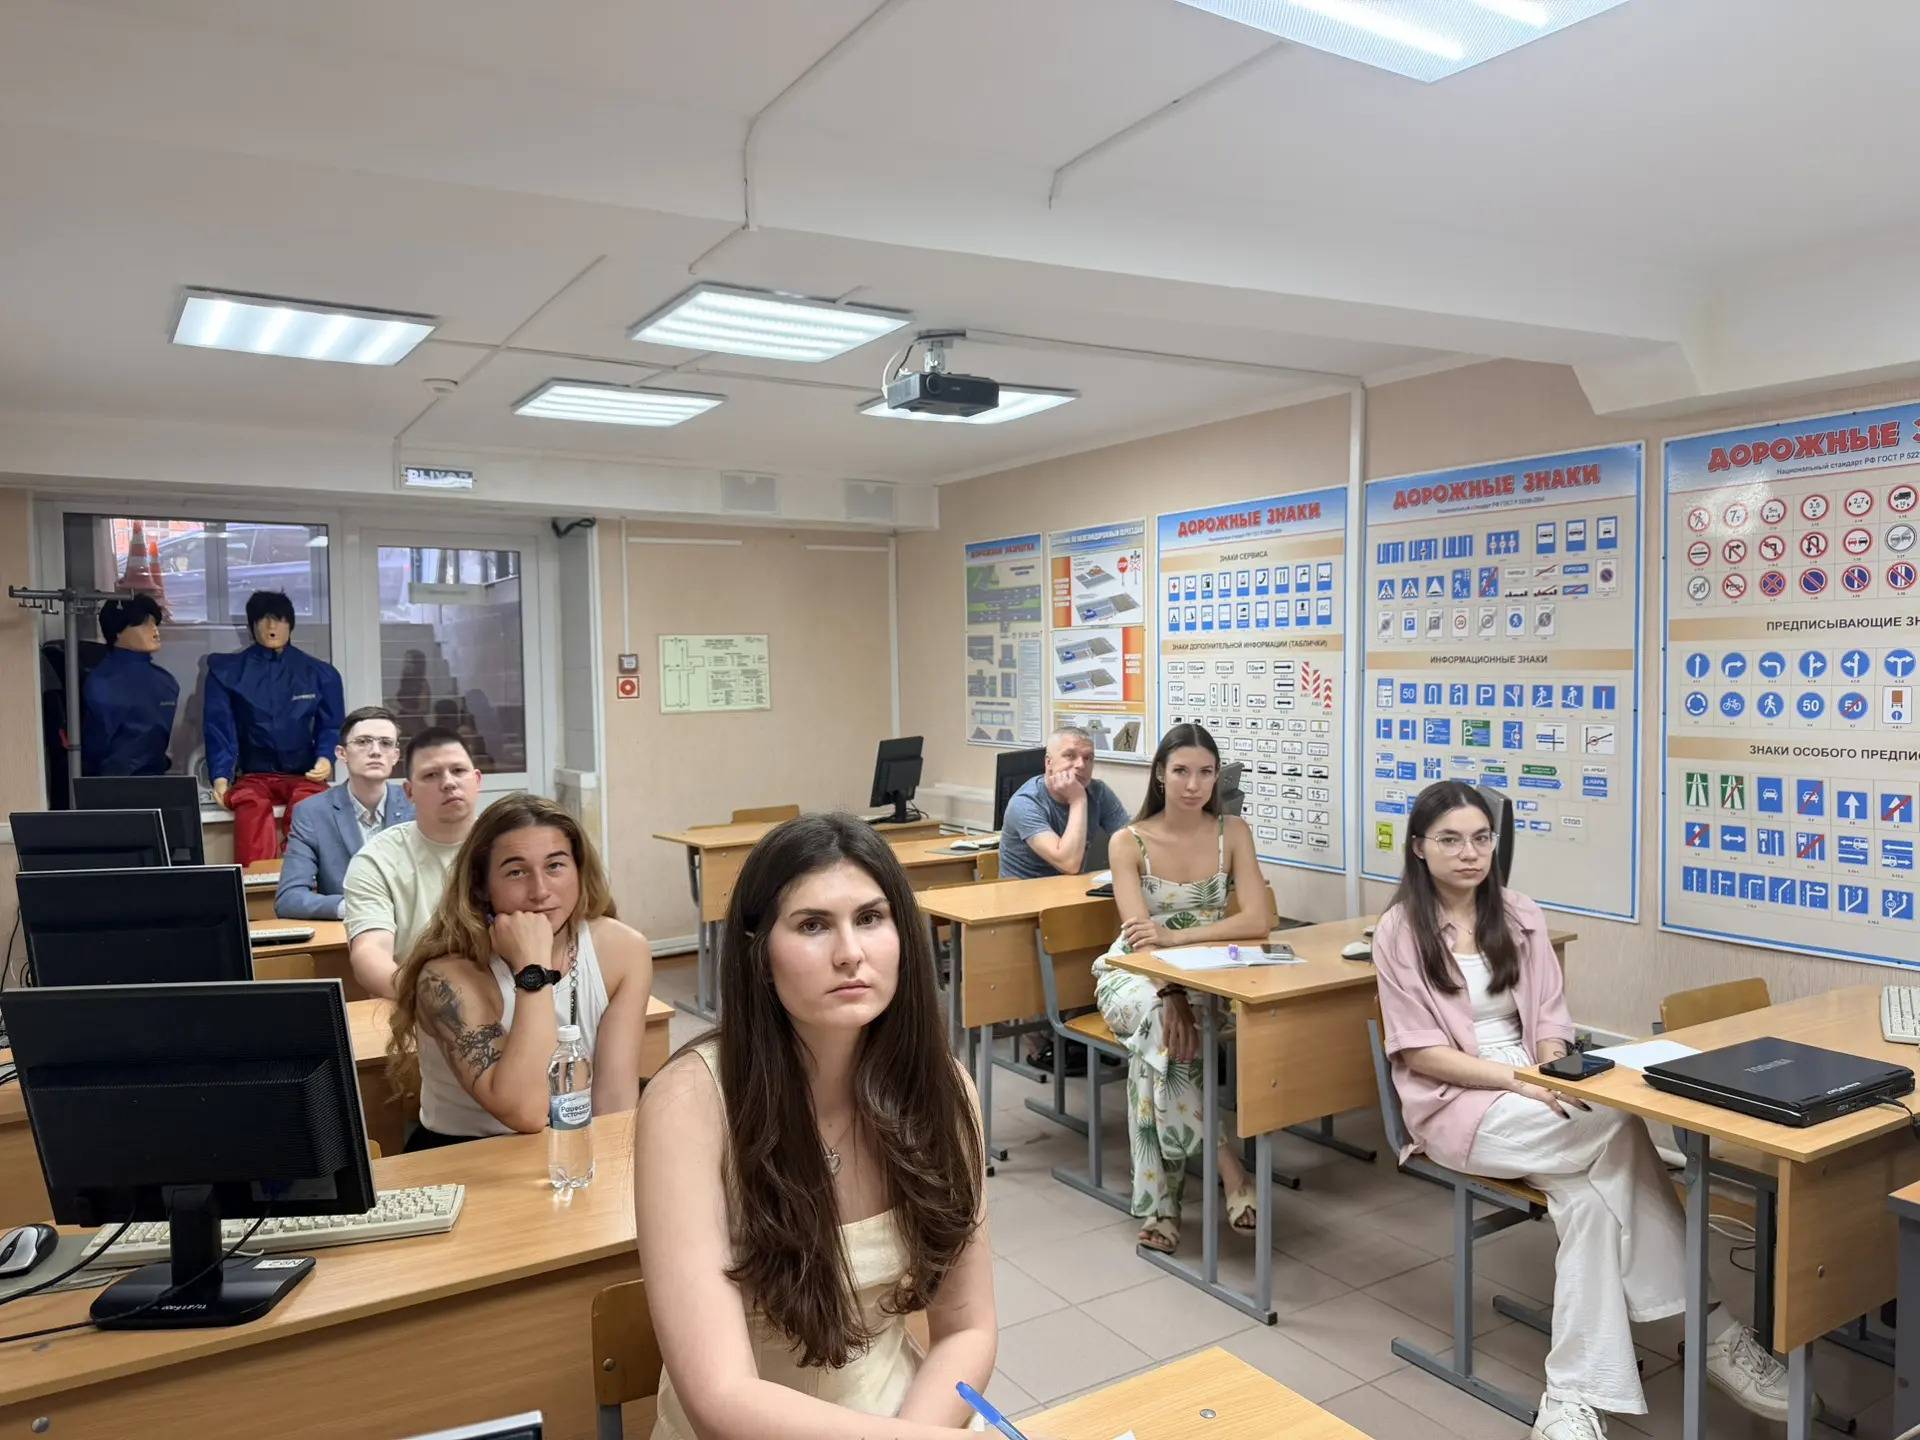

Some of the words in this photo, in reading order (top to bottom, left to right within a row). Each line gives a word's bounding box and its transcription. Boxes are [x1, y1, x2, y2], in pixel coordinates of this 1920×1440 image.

[1707, 421, 1900, 472] ДОРОЖНЫЕ
[1776, 464, 1828, 475] Национальный
[1831, 459, 1862, 470] стандарт
[1864, 456, 1876, 464] РФ
[1878, 453, 1898, 463] ГОСТ
[1392, 474, 1516, 511] ДОРОЖНЫЕ
[1522, 464, 1601, 492] ЗНАКИ
[1178, 510, 1262, 538] ДОРОЖНЫЕ
[1266, 502, 1321, 525] ЗНАКИ
[1220, 554, 1238, 563] ЗНАКИ
[1240, 550, 1268, 560] СЕРВИСА
[1766, 616, 1902, 631] ПРЕДПИСЫВАЮЩИЕ
[1190, 641, 1243, 650] ДОПОЛНИТЕЛЬНОЙ
[1244, 640, 1288, 648] ИНФОРМАЦИИ
[1288, 640, 1328, 648] (ТАБЛИЧКИ)
[1430, 655, 1516, 664] ИНФОРМАЦИОННЫЕ
[1518, 656, 1548, 664] ЗНАКИ
[1402, 688, 1414, 700] 50
[1802, 700, 1820, 712] 50
[1750, 744, 1789, 756] ЗНАКИ
[1793, 746, 1857, 759] ОСОБОГО
